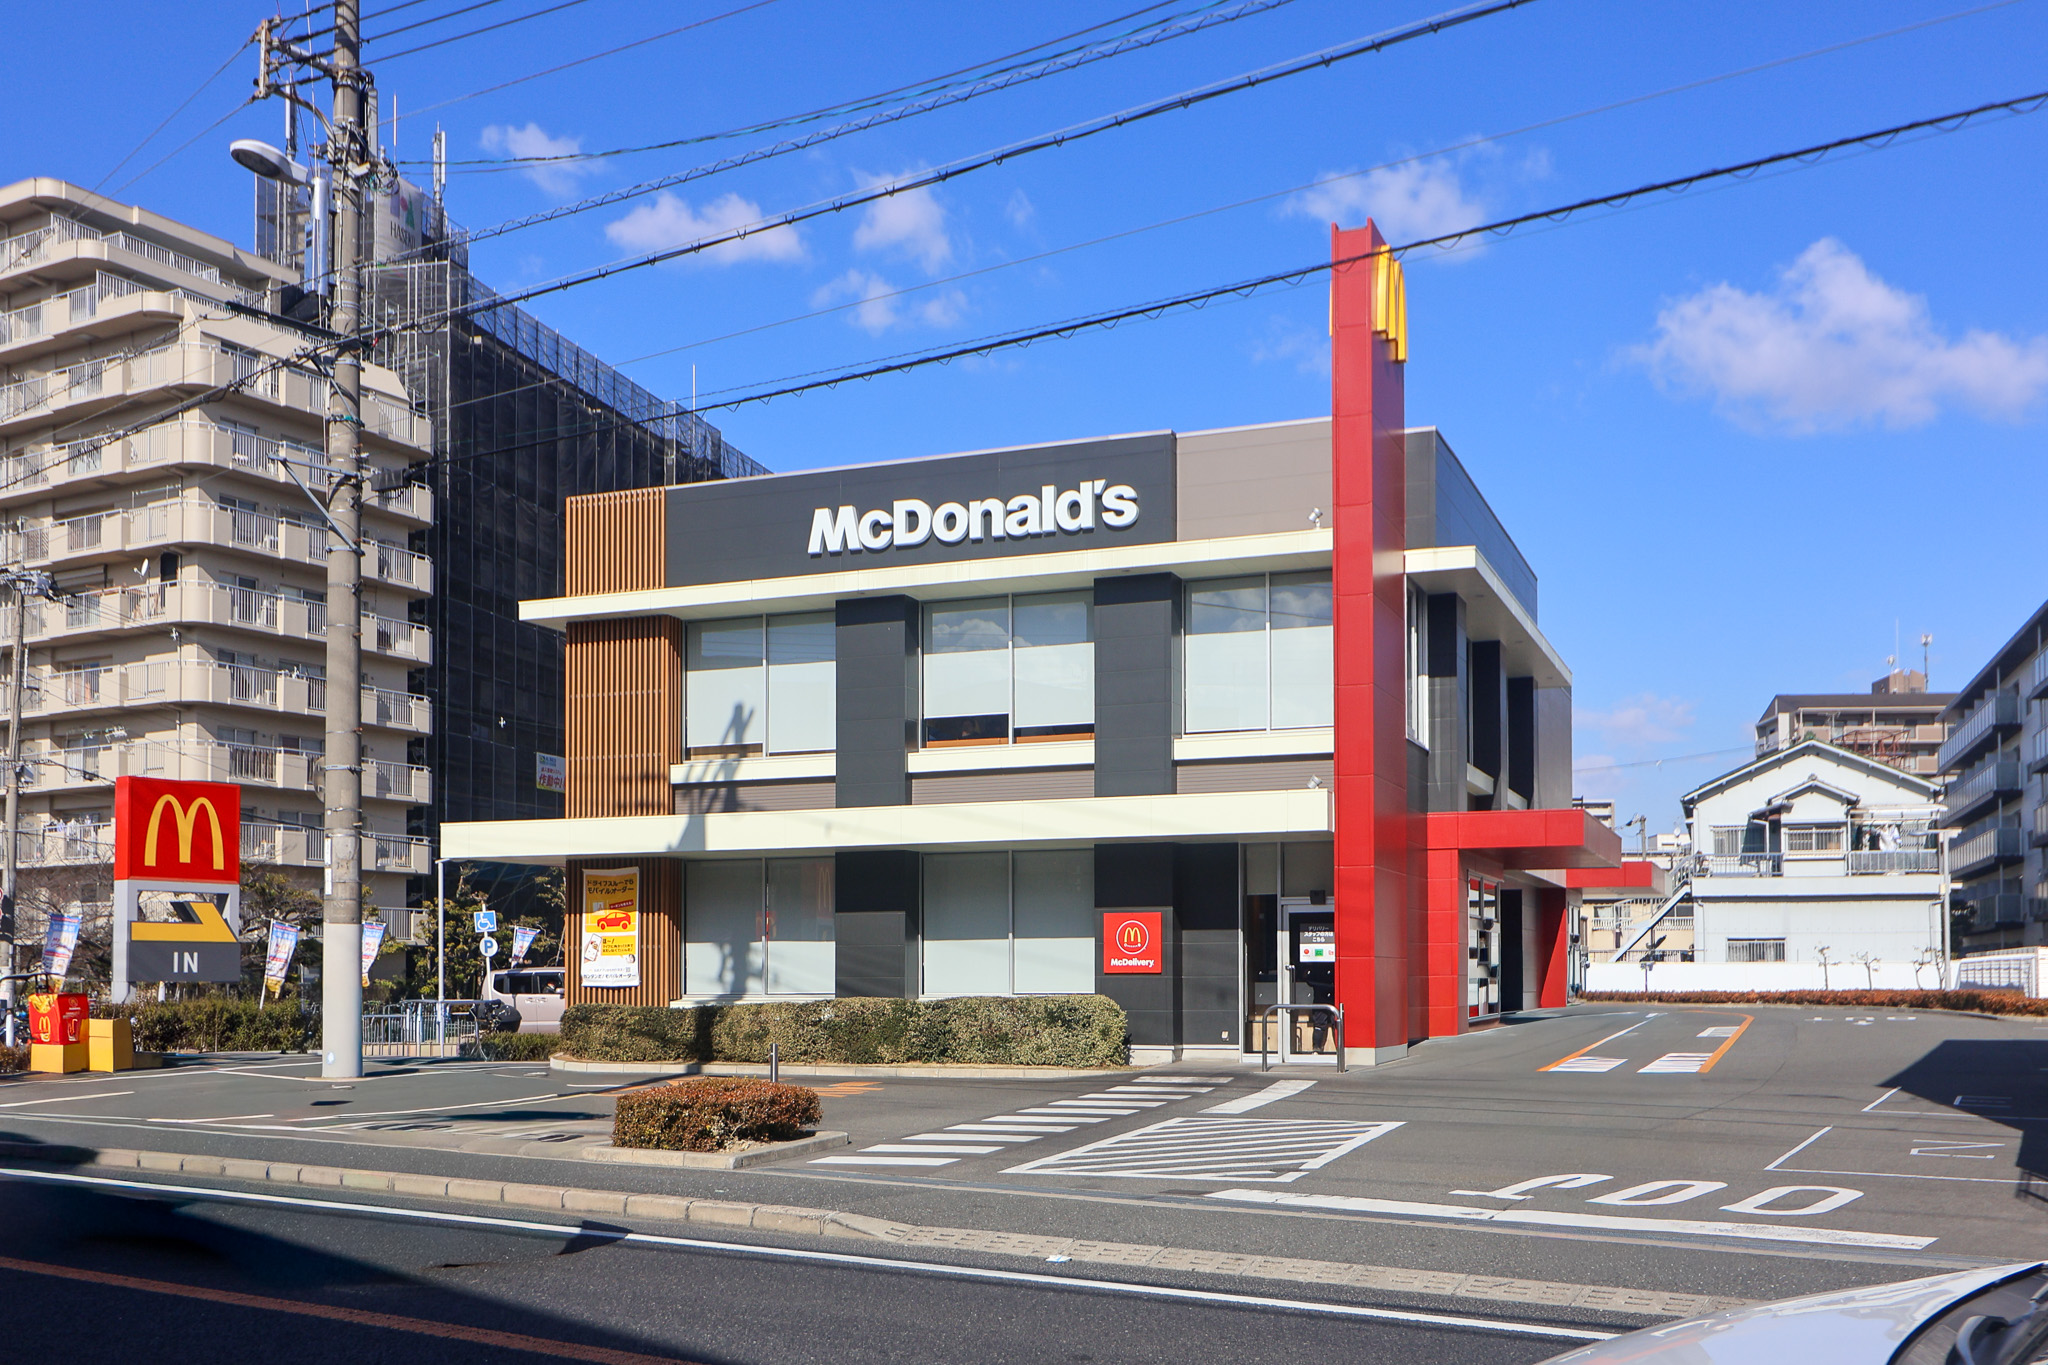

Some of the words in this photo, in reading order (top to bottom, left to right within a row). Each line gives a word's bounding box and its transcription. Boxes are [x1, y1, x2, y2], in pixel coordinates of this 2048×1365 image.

[808, 478, 1139, 555] McDonald's
[484, 940, 494, 953] P
[173, 952, 199, 974] IN
[1110, 957, 1155, 968] McDelivery
